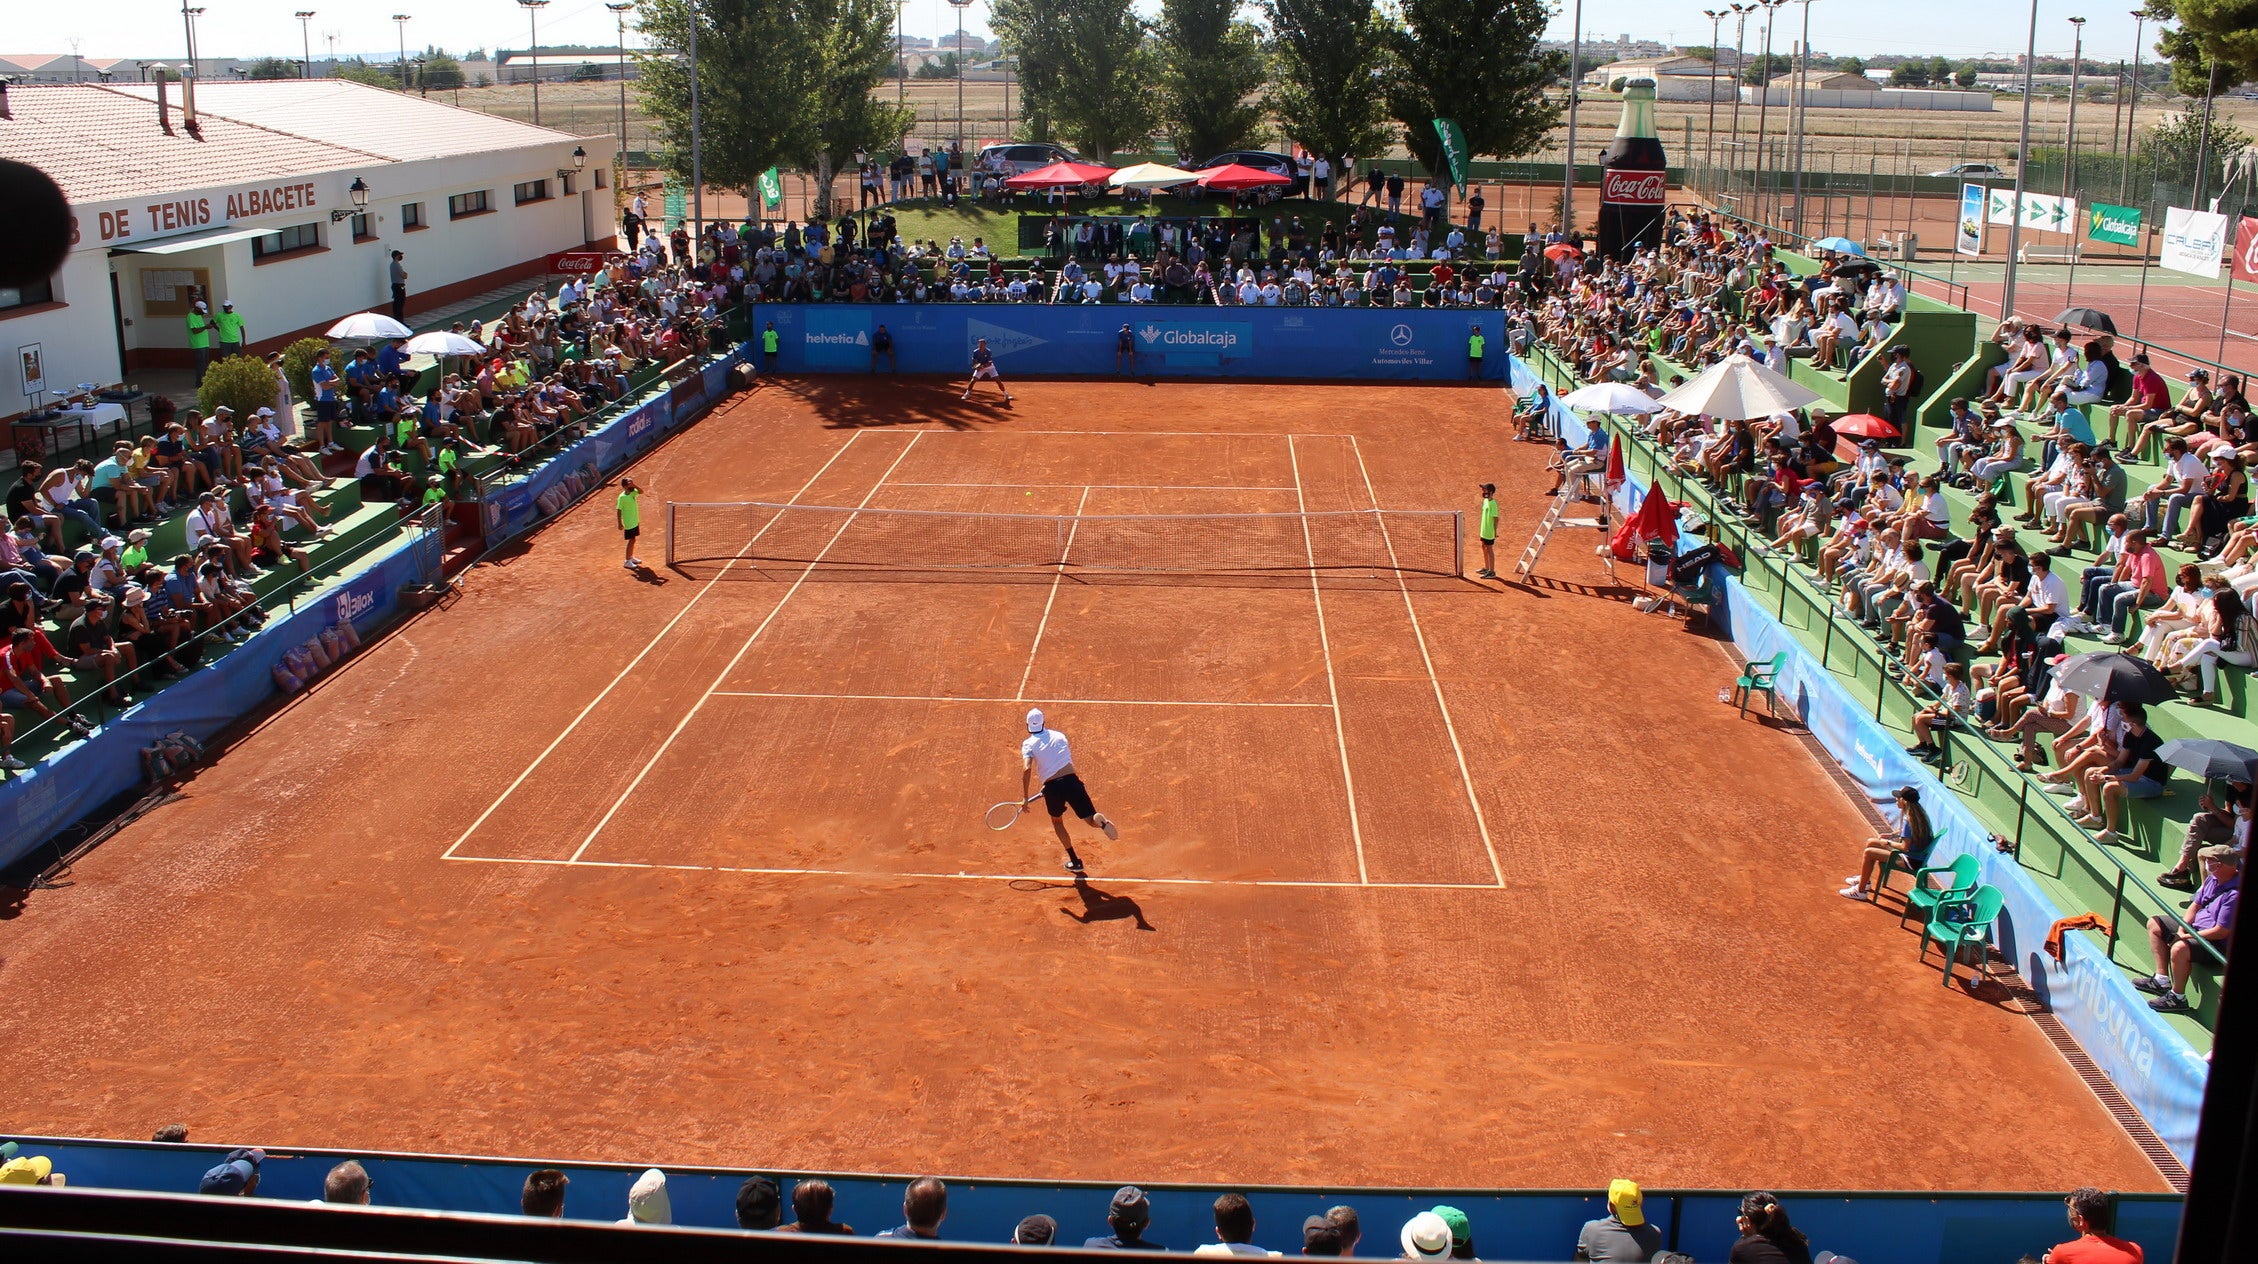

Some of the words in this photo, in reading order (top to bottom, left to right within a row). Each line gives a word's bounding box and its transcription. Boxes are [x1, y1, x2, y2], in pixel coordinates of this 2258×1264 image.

[1607, 174, 1665, 200] Coca-Cola
[99, 209, 130, 240] DE
[147, 198, 210, 232] TENIS
[225, 182, 316, 220] ALBACETE
[2103, 217, 2138, 240] Globalcaja
[557, 257, 595, 270] Coca-Cola
[806, 333, 854, 344] helvetia
[1163, 330, 1237, 348] Globalcaja
[1677, 551, 1711, 572] HEAD
